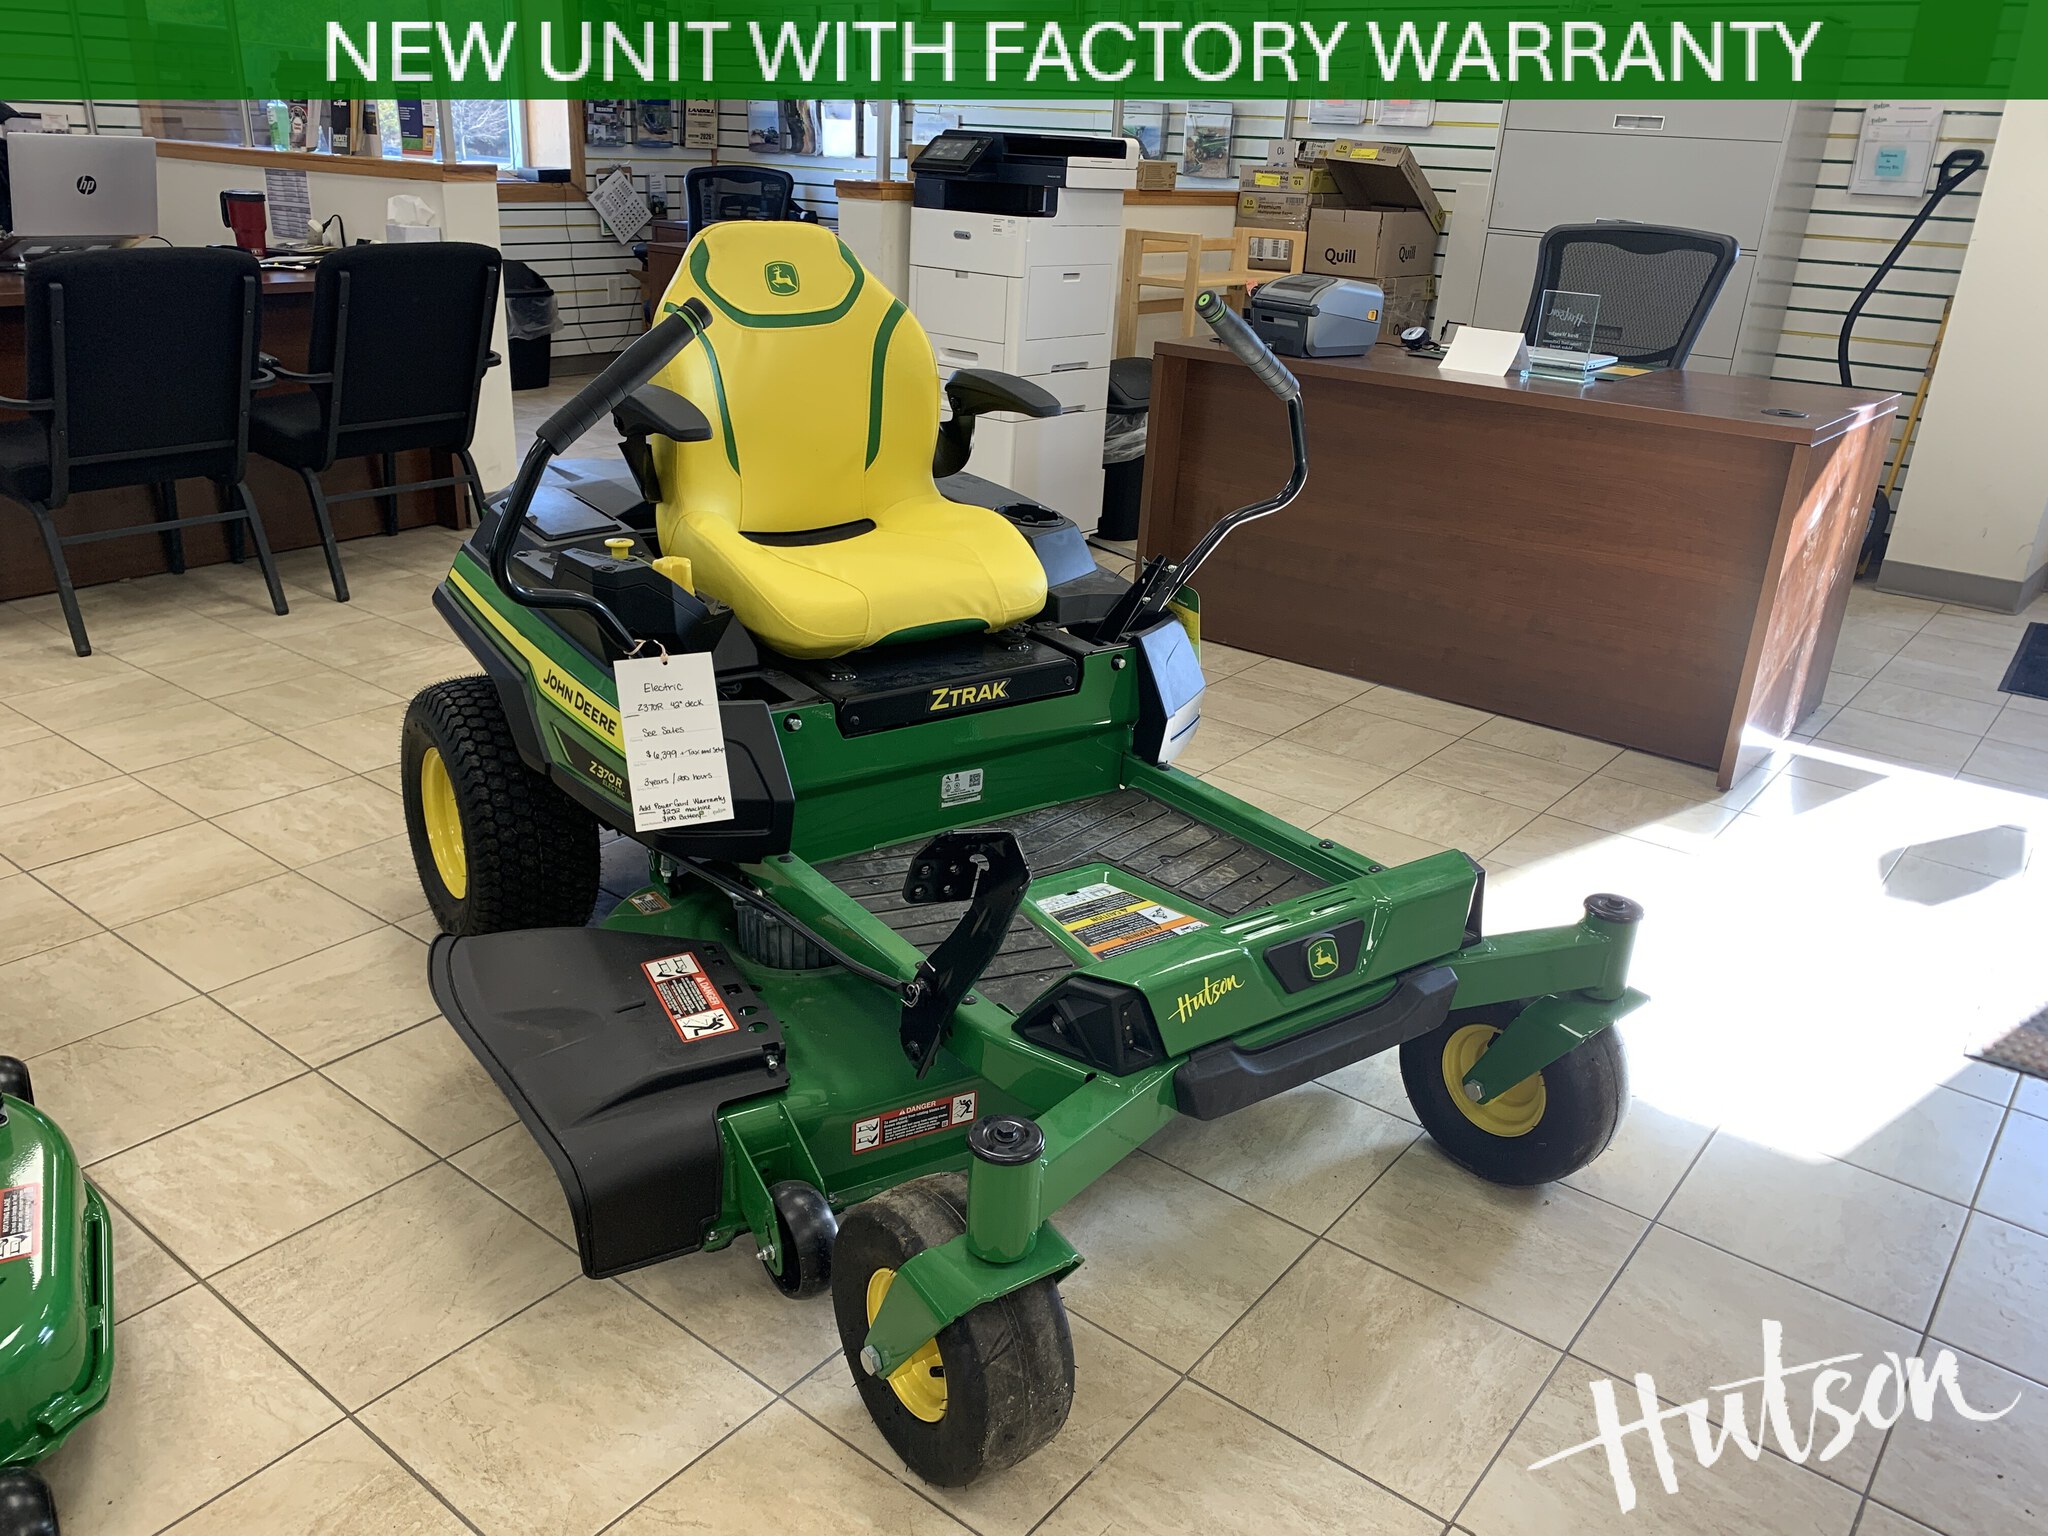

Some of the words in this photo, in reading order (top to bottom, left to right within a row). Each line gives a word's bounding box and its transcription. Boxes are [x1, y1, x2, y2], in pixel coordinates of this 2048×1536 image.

[78, 176, 95, 195] hp
[1325, 248, 1356, 265] Quill
[1399, 246, 1416, 263] Quill
[643, 682, 684, 693] Electric
[929, 680, 1007, 711] ZTRAK
[543, 669, 573, 704] JOHN
[574, 691, 617, 737] DEERE
[637, 702, 664, 712] Z370R
[685, 699, 704, 708] deck
[642, 728, 658, 738] See
[661, 726, 685, 735] Sales
[589, 760, 623, 789] Z370R
[692, 772, 713, 780] hours
[602, 779, 626, 798] ELECTRIC
[639, 804, 651, 812] Add
[1090, 909, 1121, 922] CAUTION
[701, 981, 720, 1006] DANGER
[1167, 974, 1245, 1023] Hutson
[906, 1100, 936, 1114] DANGER
